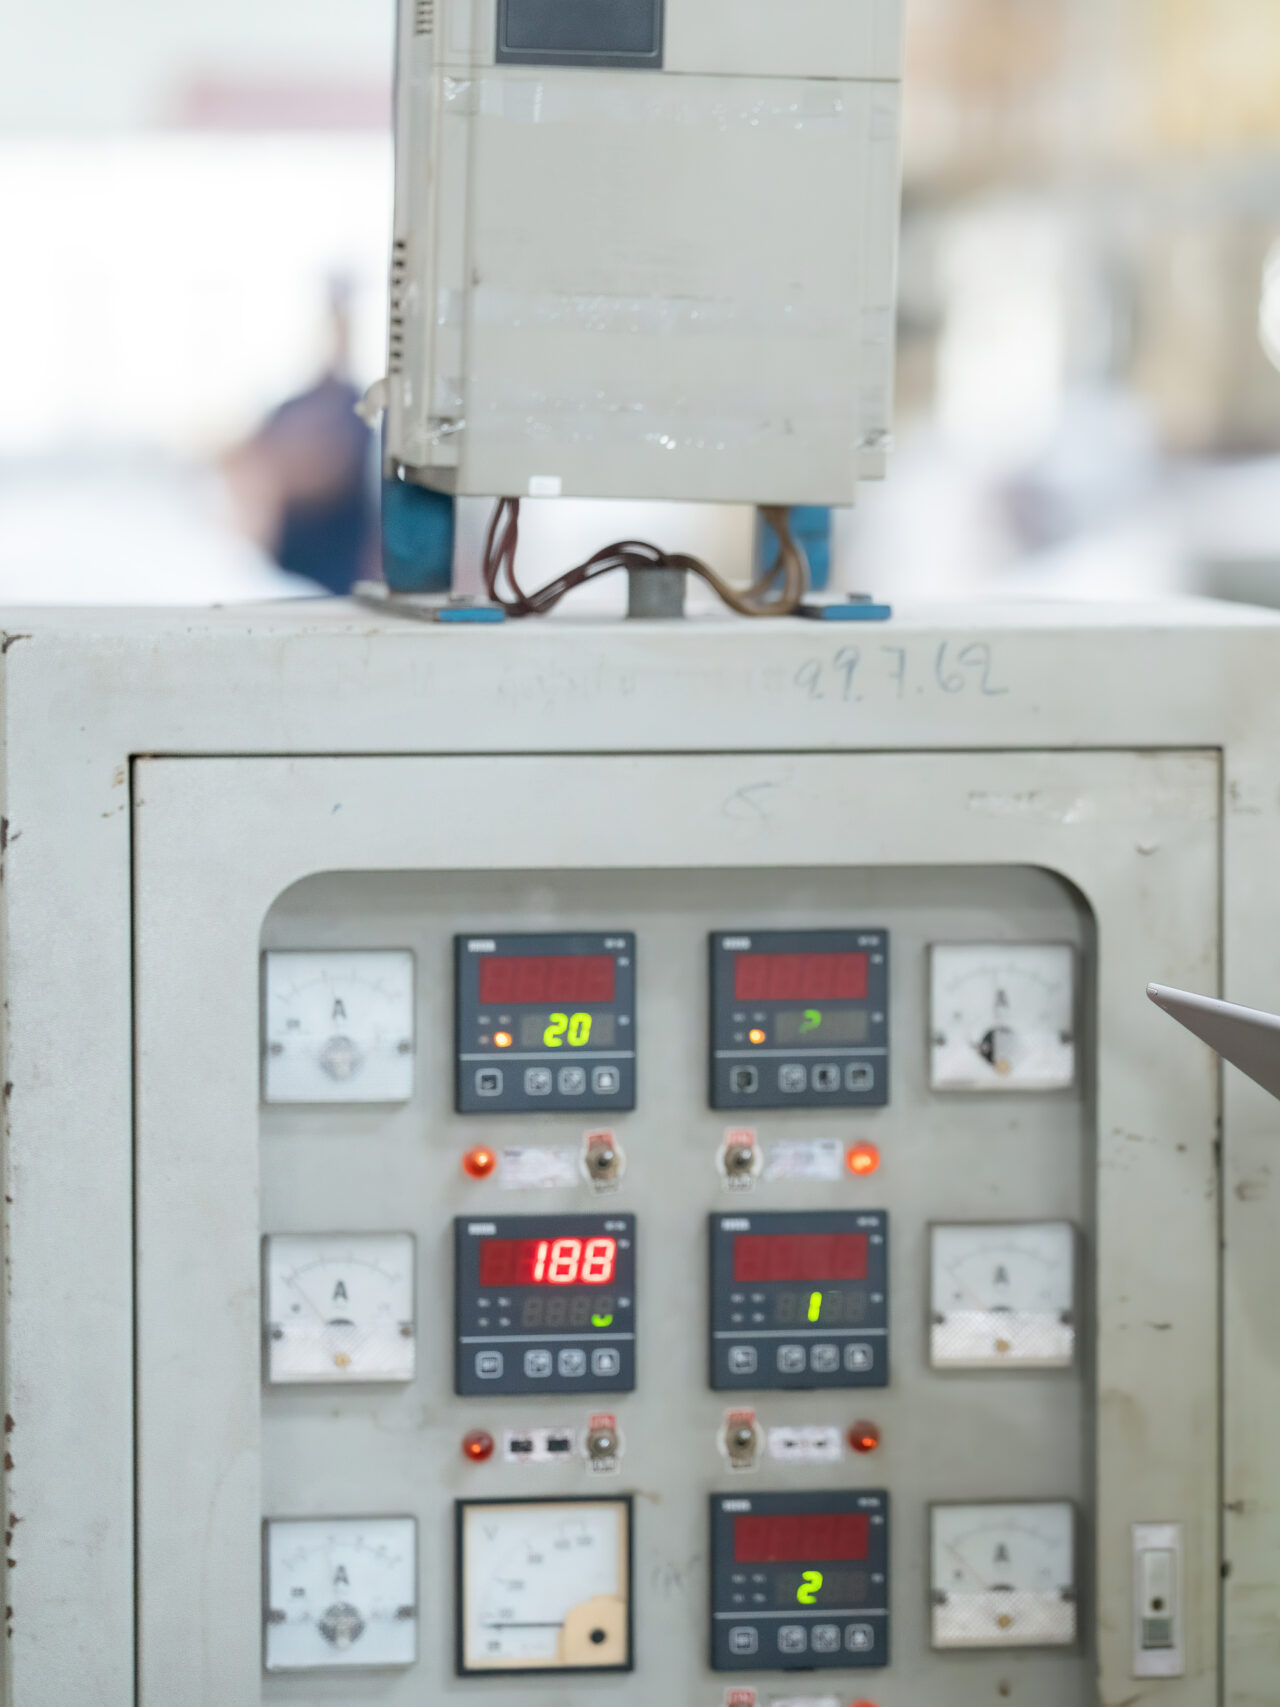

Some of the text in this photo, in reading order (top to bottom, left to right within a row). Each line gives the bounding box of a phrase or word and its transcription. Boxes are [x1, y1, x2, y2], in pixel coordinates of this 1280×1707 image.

[331, 998, 348, 1020] A
[993, 989, 1009, 1009] A
[543, 1012, 593, 1047] 20
[532, 1236, 617, 1284] 188
[993, 1265, 1009, 1286] A
[332, 1280, 348, 1301] A
[806, 1290, 823, 1323] 1
[333, 1565, 349, 1586] A
[796, 1569, 824, 1605] 2
